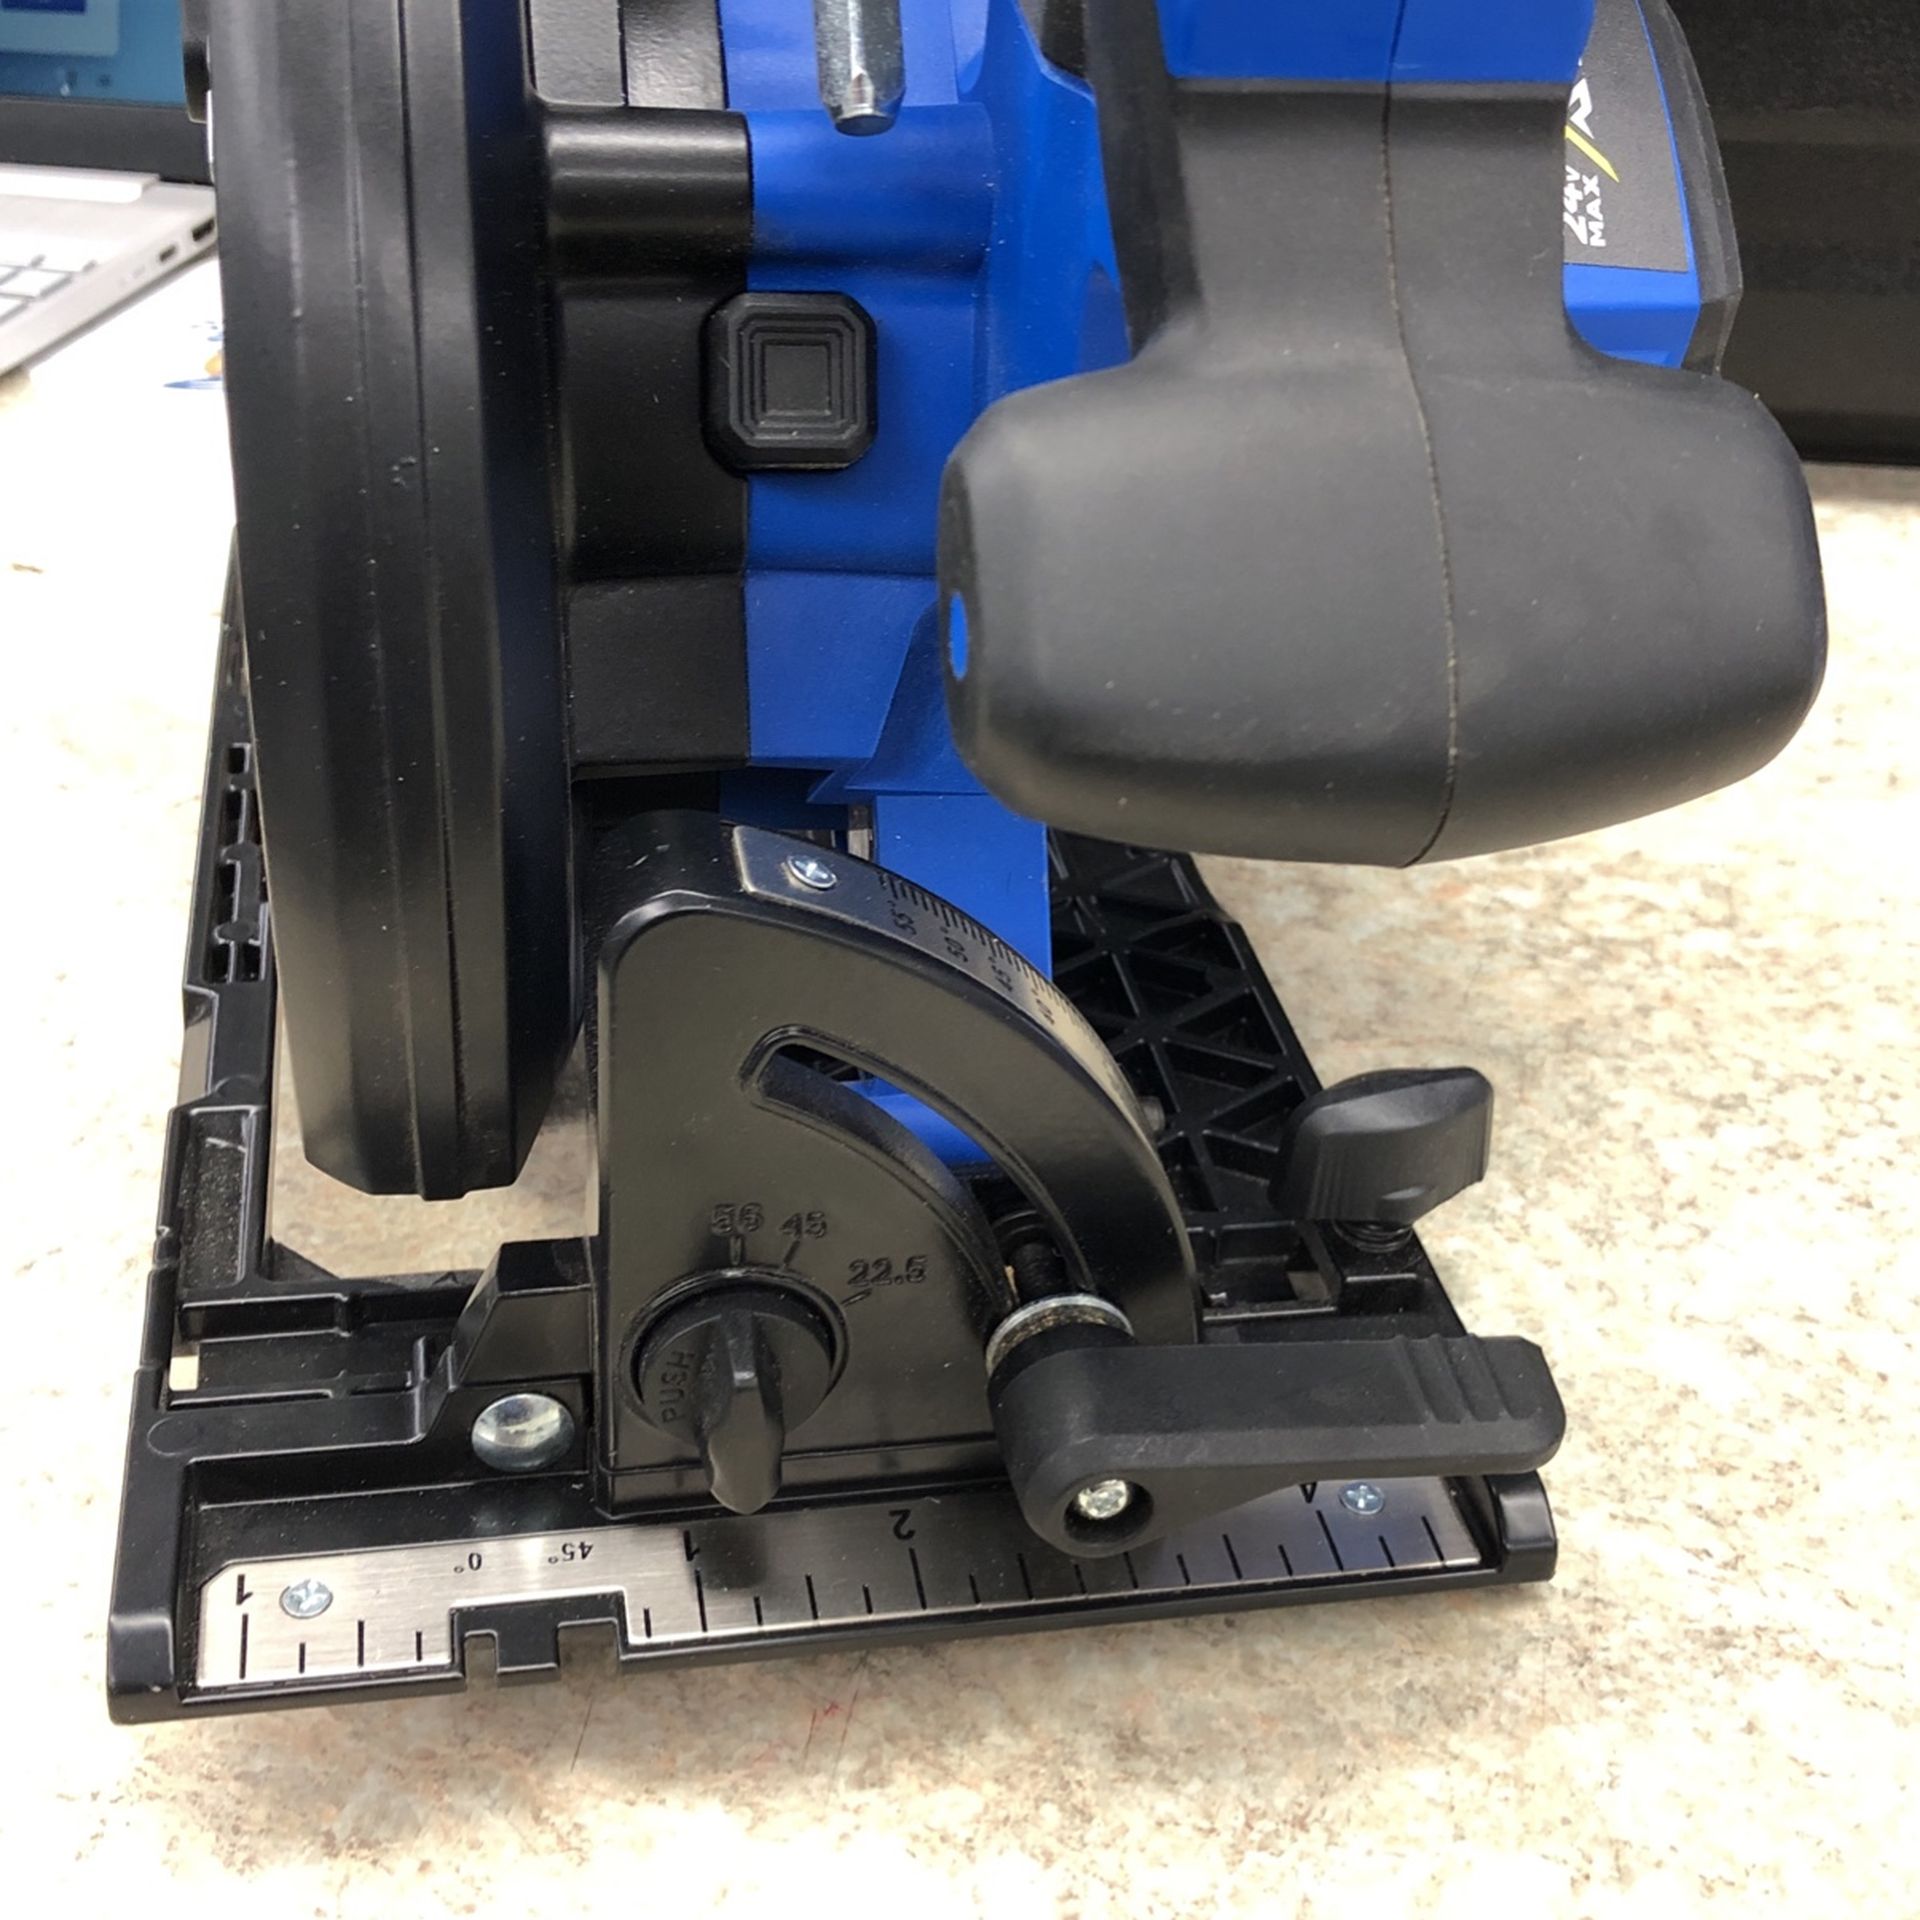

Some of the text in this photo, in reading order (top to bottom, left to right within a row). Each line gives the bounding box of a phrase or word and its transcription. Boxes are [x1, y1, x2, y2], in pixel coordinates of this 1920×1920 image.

[1563, 164, 1588, 245] 24V
[1582, 174, 1606, 247] MAX
[779, 1210, 828, 1239] 45
[847, 1255, 928, 1288] 22.5
[660, 1350, 695, 1424] PUSH
[888, 1509, 916, 1540] 2
[547, 1540, 594, 1565] 45°
[683, 1530, 701, 1562] 1
[236, 1574, 253, 1606] 1
